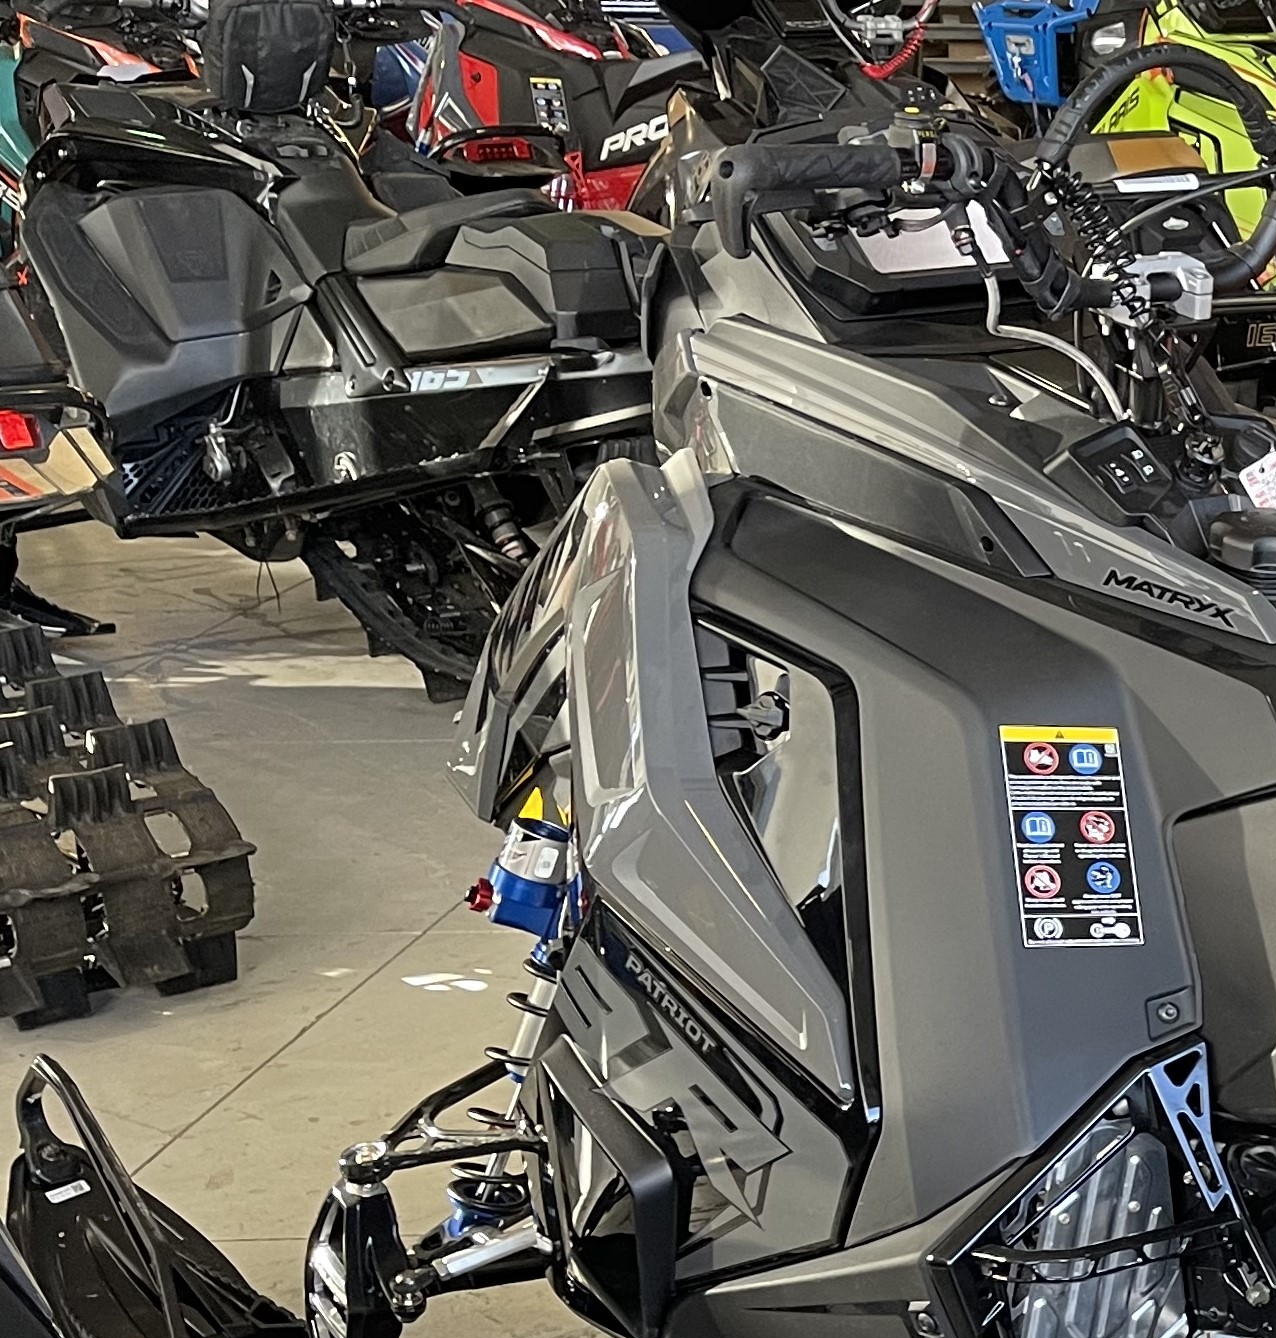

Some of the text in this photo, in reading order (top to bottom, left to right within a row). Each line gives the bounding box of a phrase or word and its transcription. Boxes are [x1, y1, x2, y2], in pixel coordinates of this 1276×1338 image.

[600, 113, 670, 162] PRO
[1103, 569, 1235, 629] MATRYX
[625, 954, 717, 1052] PATRIOT
